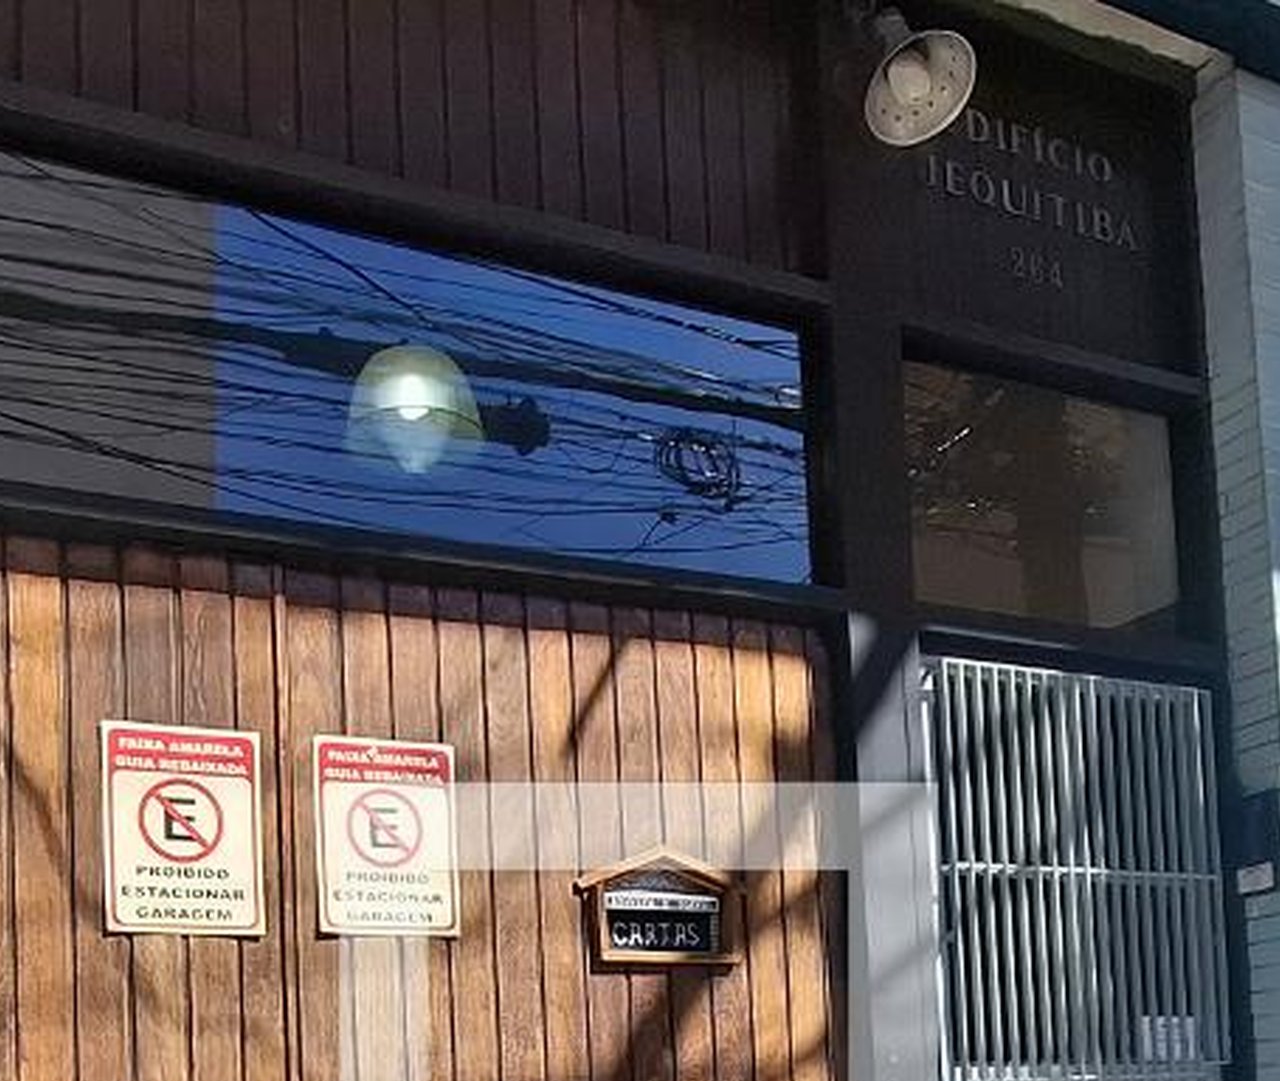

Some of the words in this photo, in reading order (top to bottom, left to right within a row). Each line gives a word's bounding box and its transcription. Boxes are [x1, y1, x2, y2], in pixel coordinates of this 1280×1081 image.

[117, 736, 166, 751] FAIXA
[168, 741, 244, 758] AMARELA
[115, 755, 156, 769] GUIA
[135, 866, 230, 880] PROIBIDO
[346, 871, 430, 885] PROIBIDO
[121, 886, 245, 901] ESTACIONAR
[333, 889, 444, 906] ESTACIONAR
[135, 907, 232, 922] GARAGEM
[612, 922, 701, 947] CARTAS
